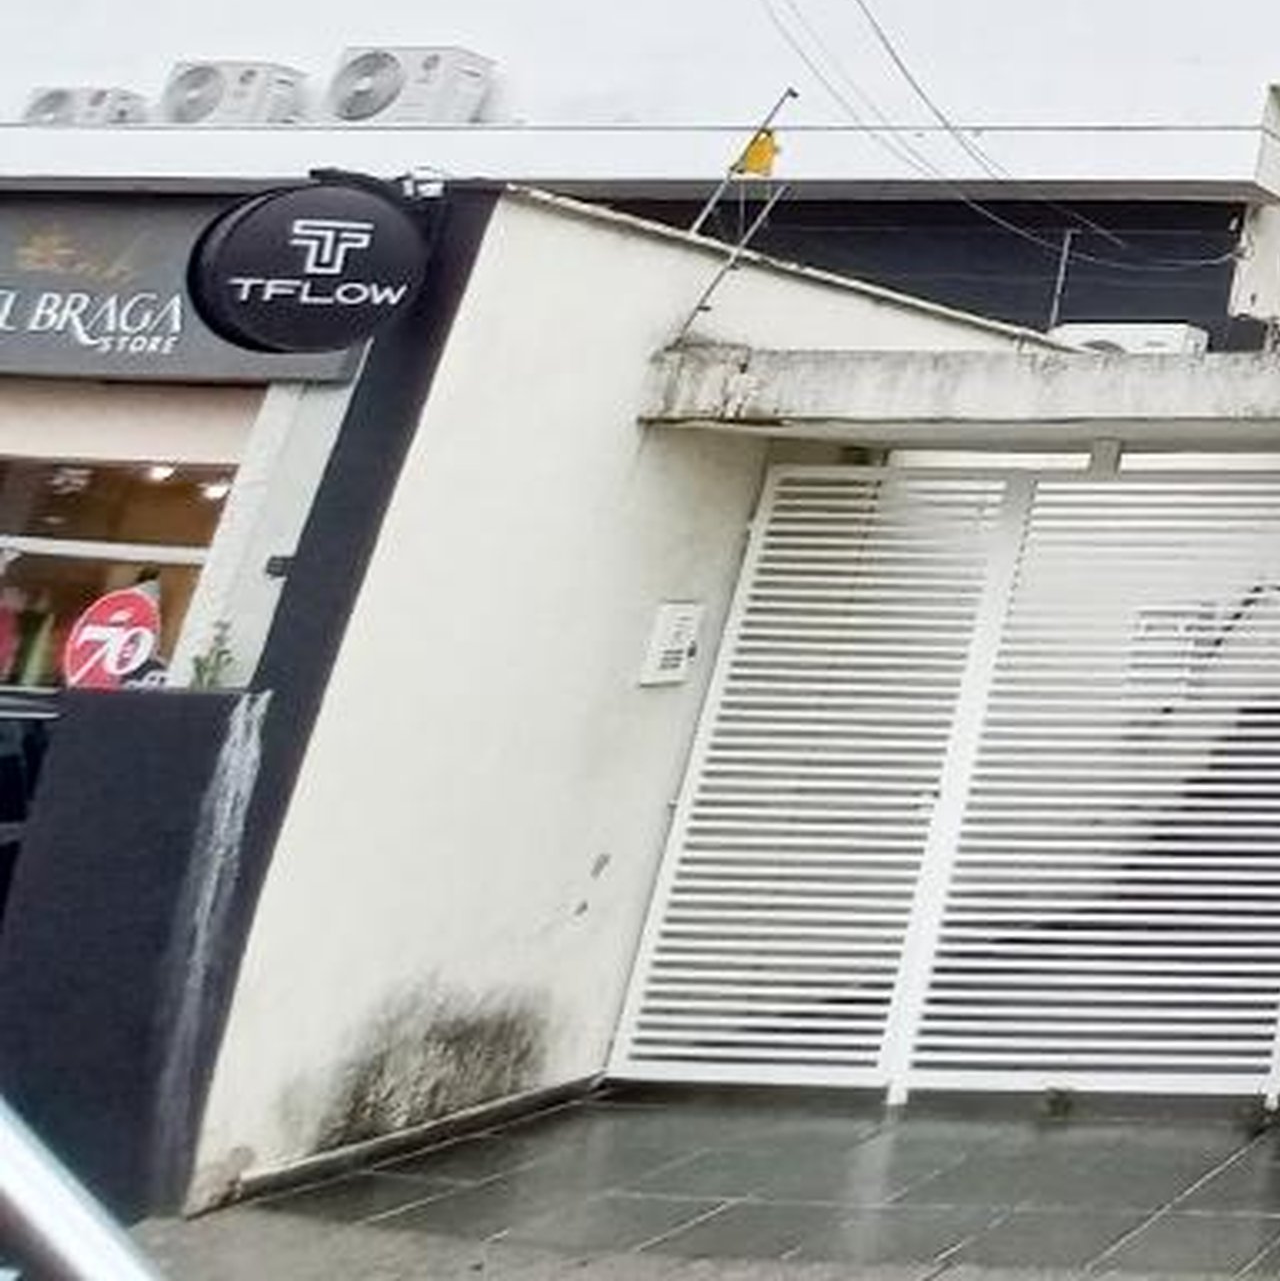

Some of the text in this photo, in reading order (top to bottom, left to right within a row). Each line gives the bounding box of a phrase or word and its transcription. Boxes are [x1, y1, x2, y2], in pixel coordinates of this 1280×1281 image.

[228, 277, 408, 305] TFLOW
[28, 291, 182, 345] BRAGA
[97, 335, 179, 354] STORE
